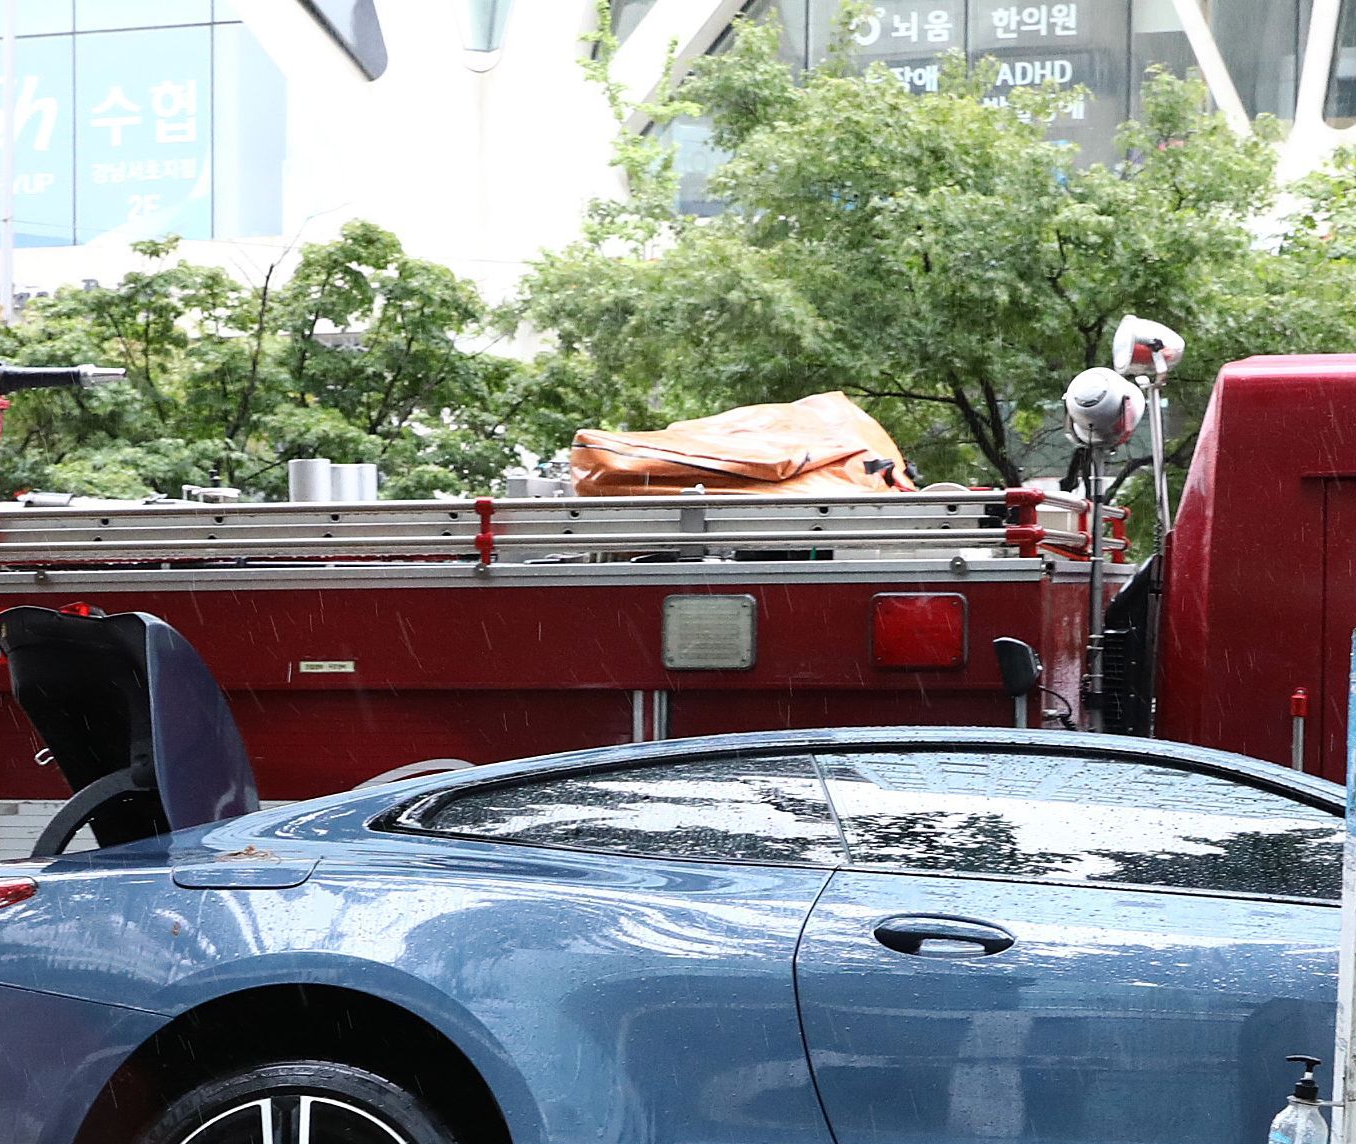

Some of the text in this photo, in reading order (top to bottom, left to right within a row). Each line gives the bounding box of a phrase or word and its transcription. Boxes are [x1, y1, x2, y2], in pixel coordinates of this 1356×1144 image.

[891, 4, 1078, 43] 뇌움 한의원
[996, 59, 1073, 87] ADHD
[90, 78, 198, 148] 수협
